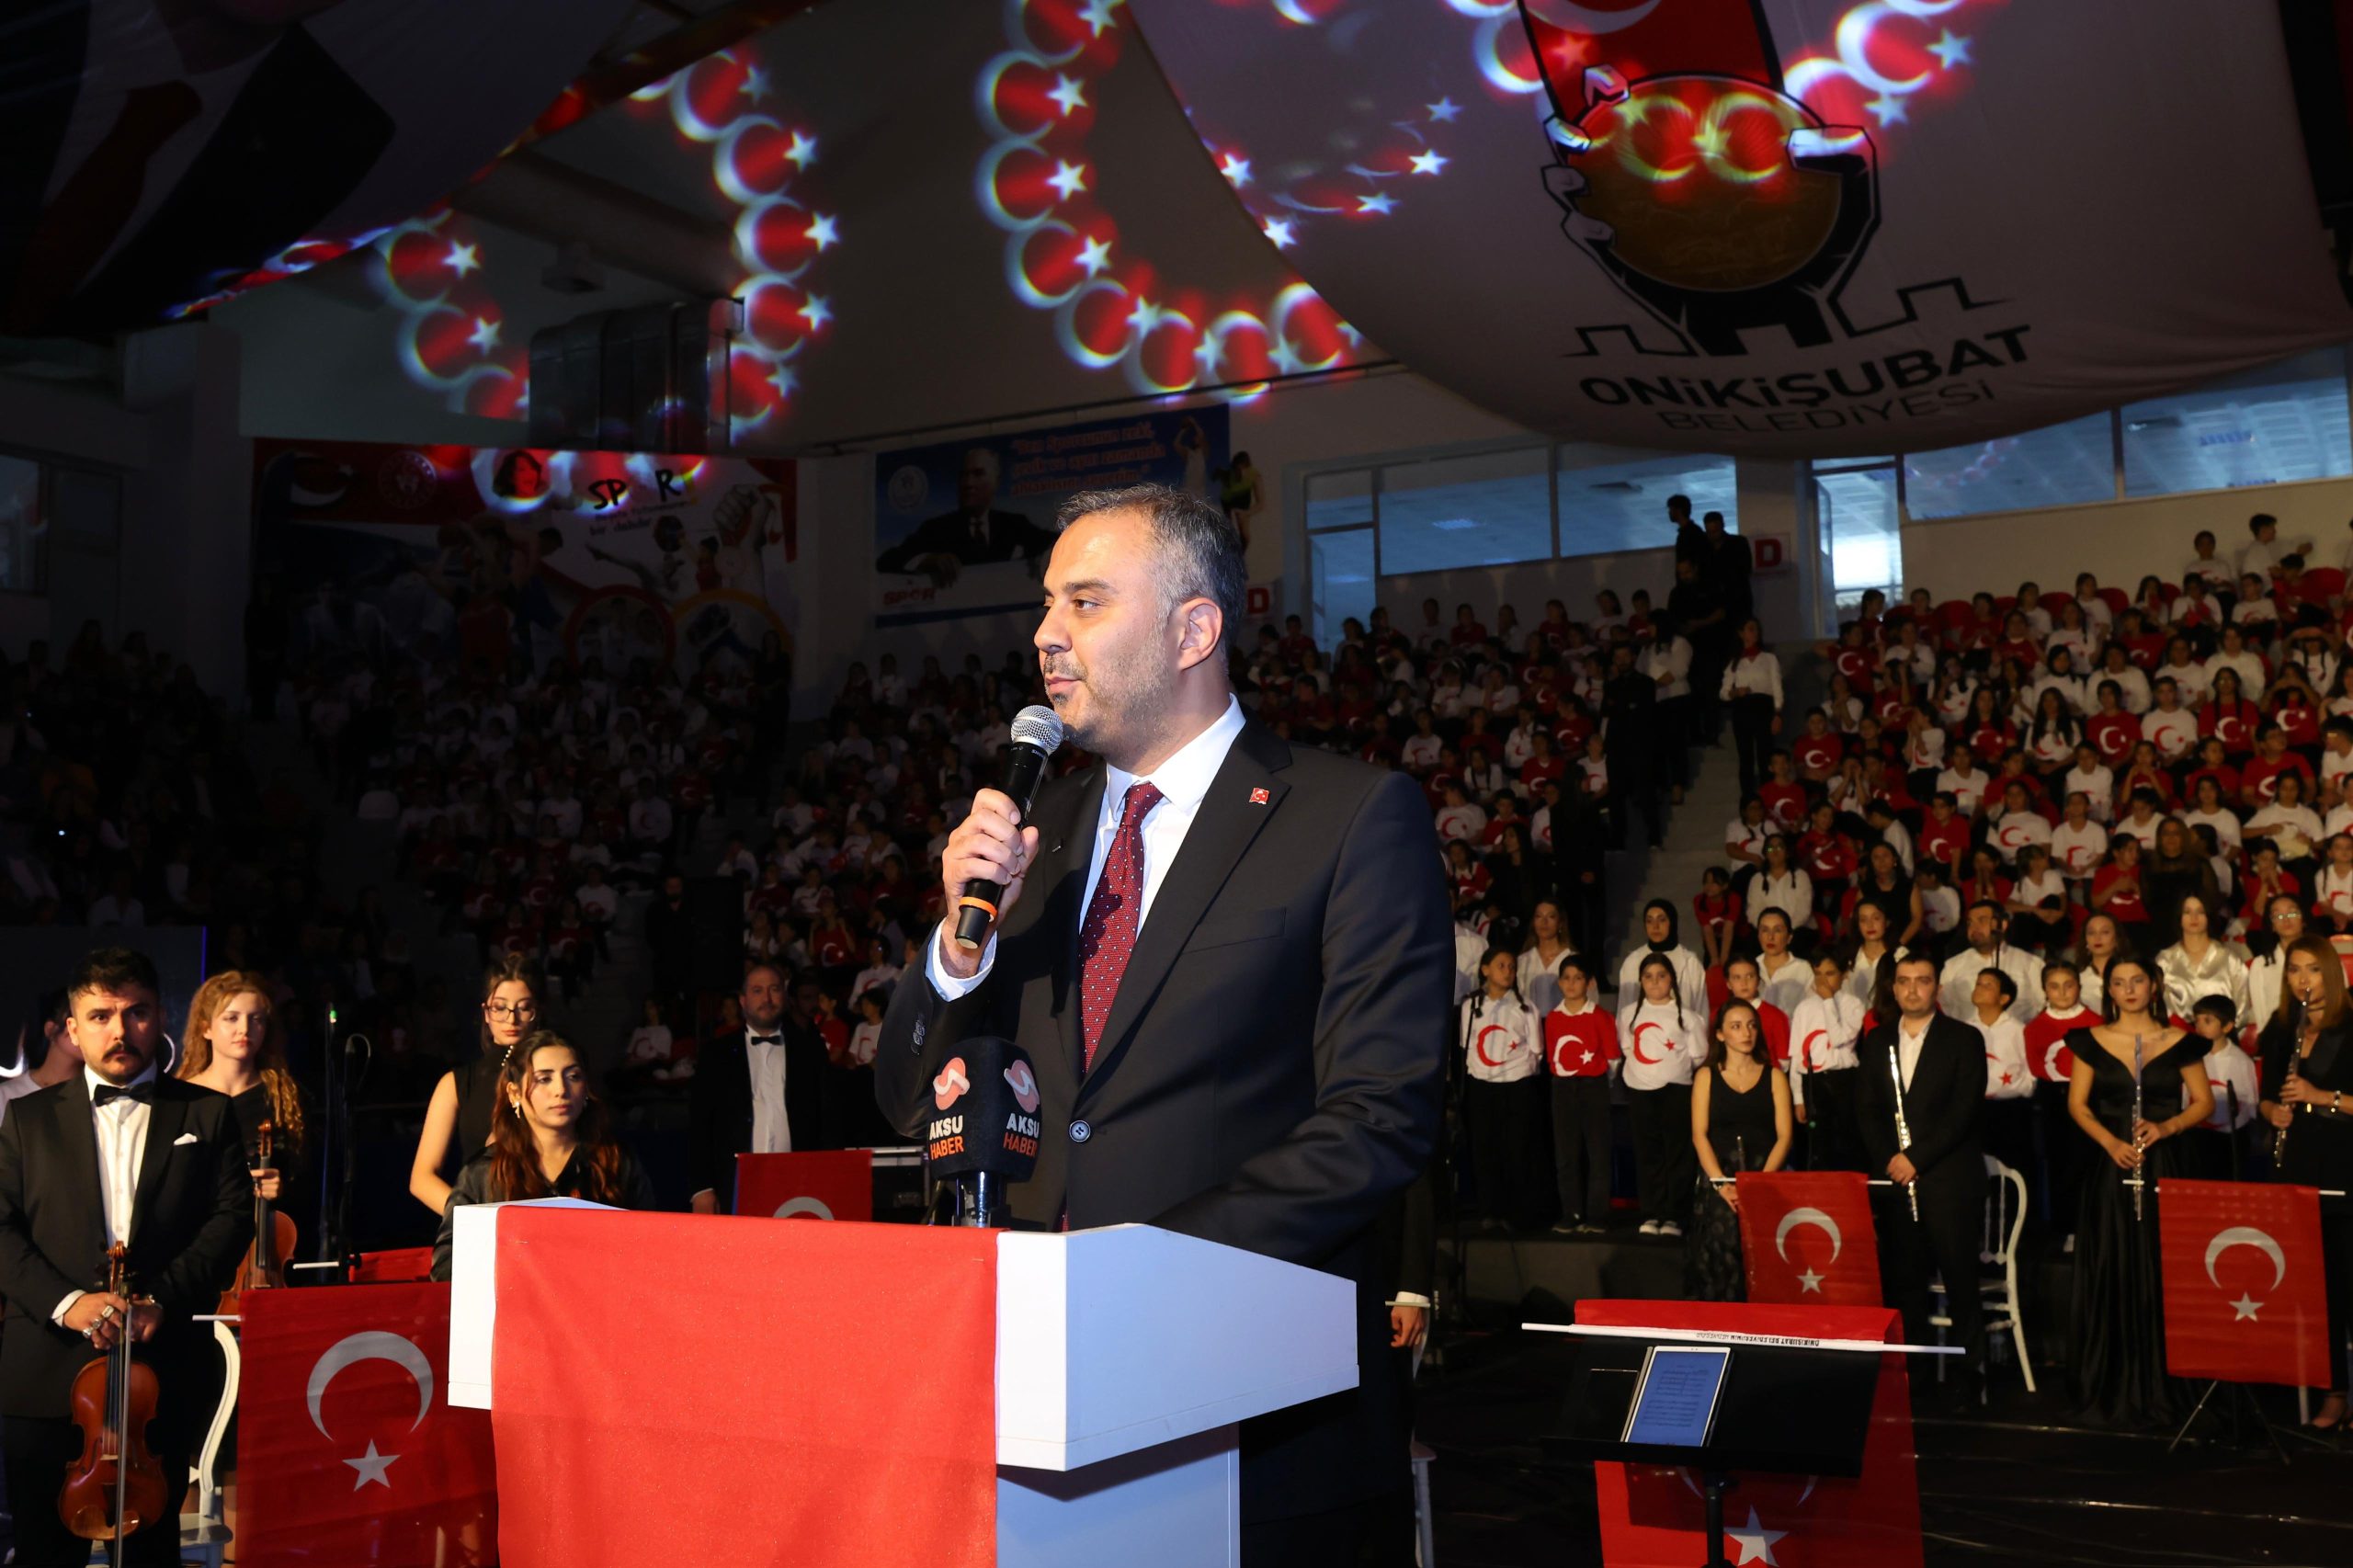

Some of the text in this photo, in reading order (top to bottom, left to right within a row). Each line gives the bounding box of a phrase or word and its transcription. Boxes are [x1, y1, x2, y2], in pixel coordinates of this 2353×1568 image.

[1755, 539, 1781, 567] D
[929, 1115, 963, 1140] AKSU
[1006, 1113, 1040, 1138] AKSU
[929, 1135, 964, 1160] HABER
[1004, 1131, 1038, 1156] HABER
